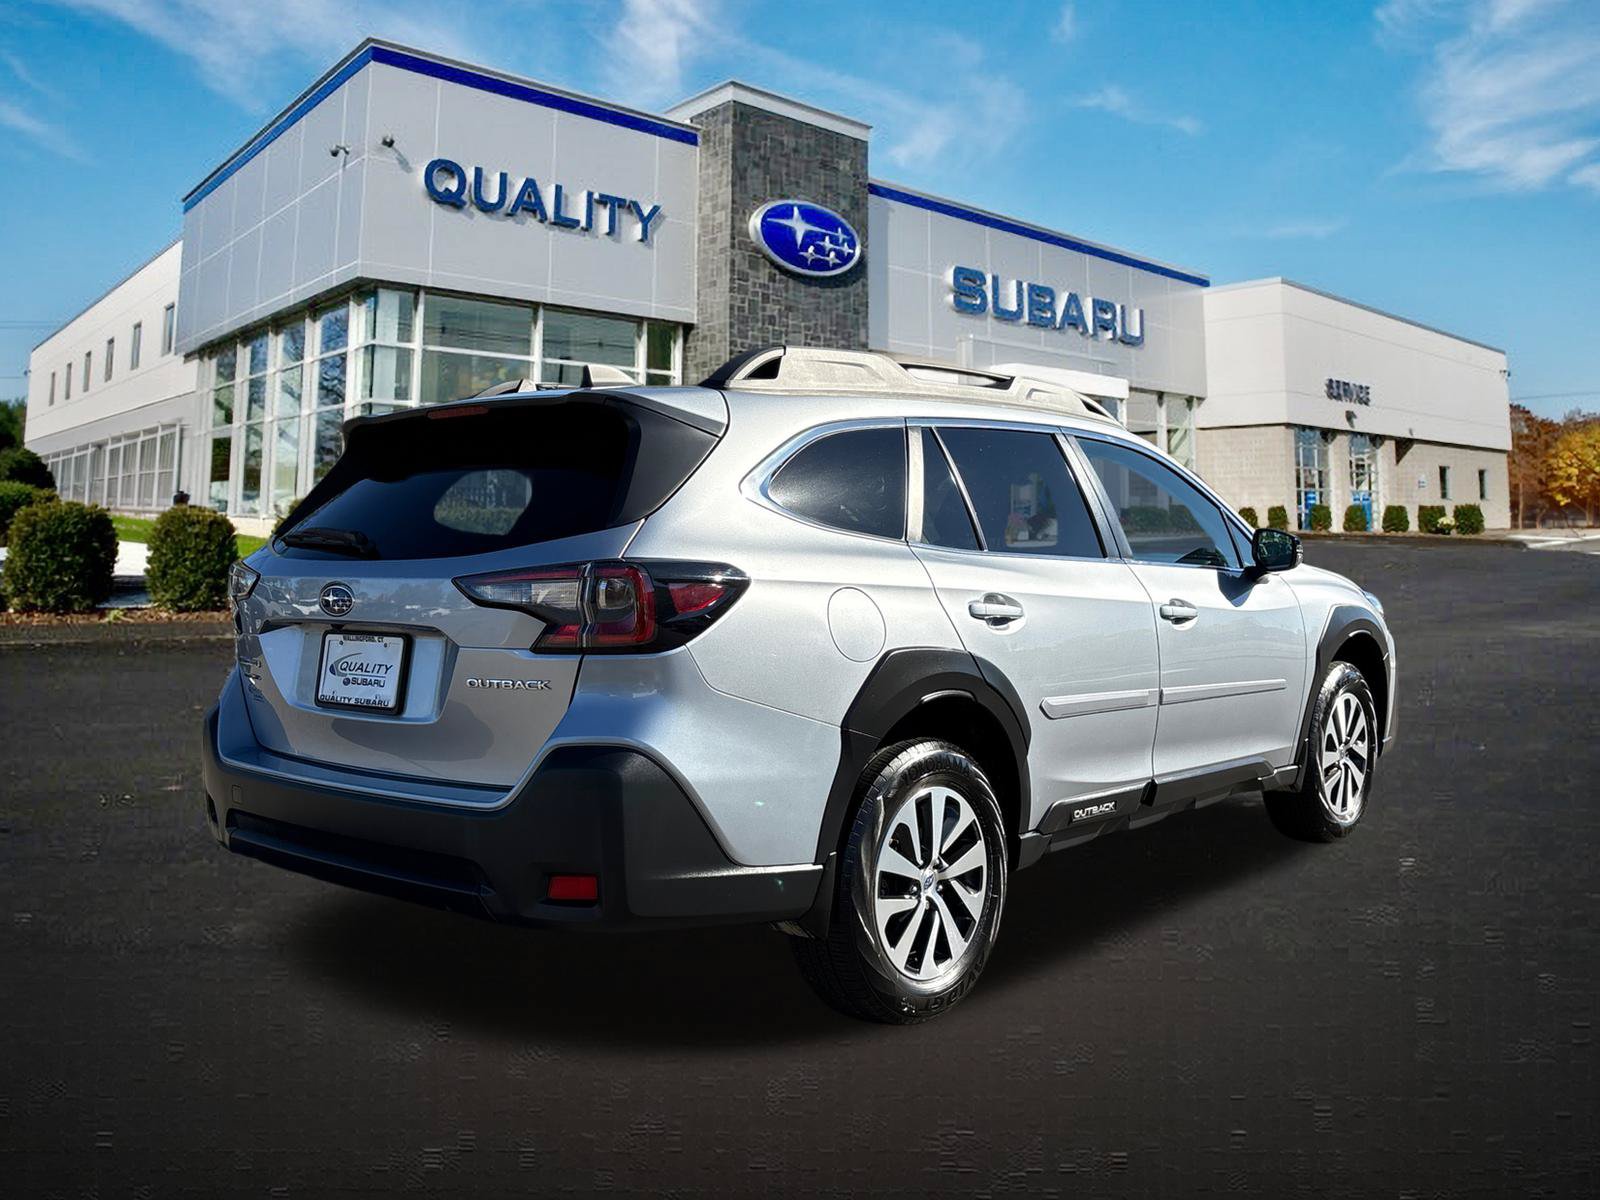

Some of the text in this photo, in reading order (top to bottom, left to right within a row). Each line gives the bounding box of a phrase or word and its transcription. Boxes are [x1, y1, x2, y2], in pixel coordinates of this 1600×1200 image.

[424, 158, 661, 242] QUALITY
[947, 265, 1145, 347] SUBARU
[1324, 378, 1370, 406] SERVICE
[340, 661, 393, 675] QUALITY
[351, 678, 386, 688] SUBARU
[466, 678, 552, 690] OUTBACK
[319, 694, 390, 707] QUALITY SUBARU
[899, 752, 972, 785] YOKOHAMA
[1074, 801, 1116, 818] OUTBACK
